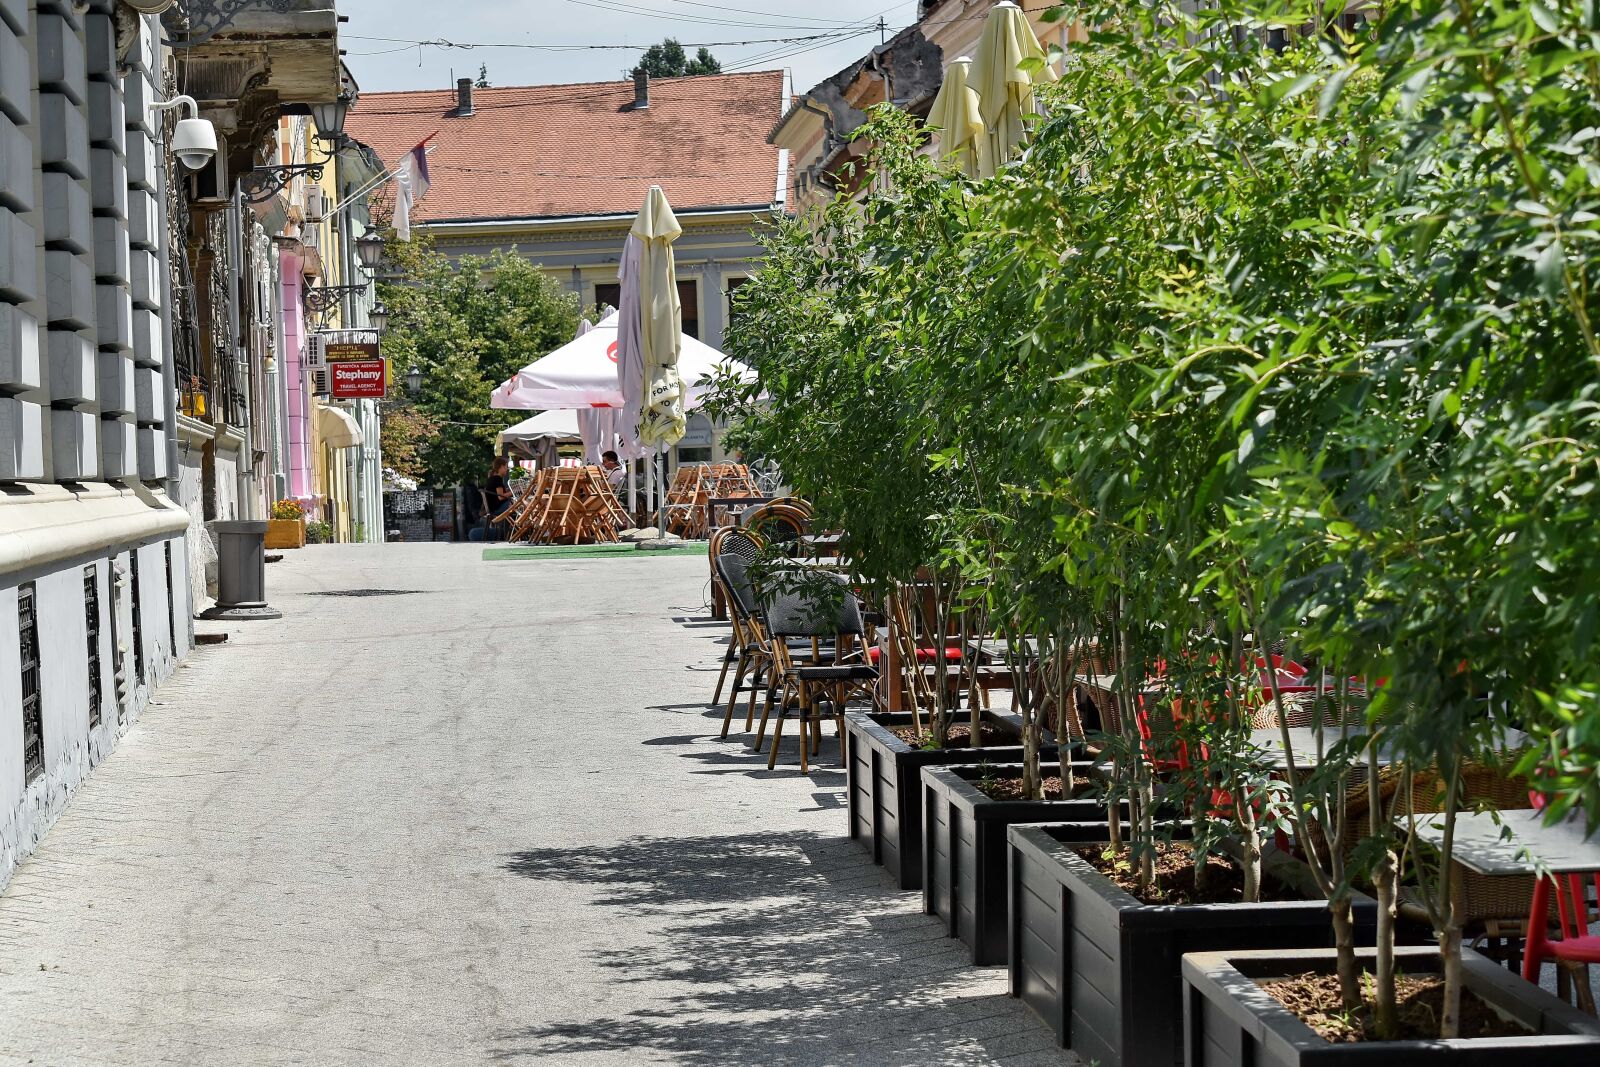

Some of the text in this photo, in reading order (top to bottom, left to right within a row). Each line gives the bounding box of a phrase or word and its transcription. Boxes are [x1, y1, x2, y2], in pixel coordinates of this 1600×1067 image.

[353, 331, 377, 344] КРЗНО
[336, 370, 381, 380] Stephany
[652, 385, 668, 396] FOR
